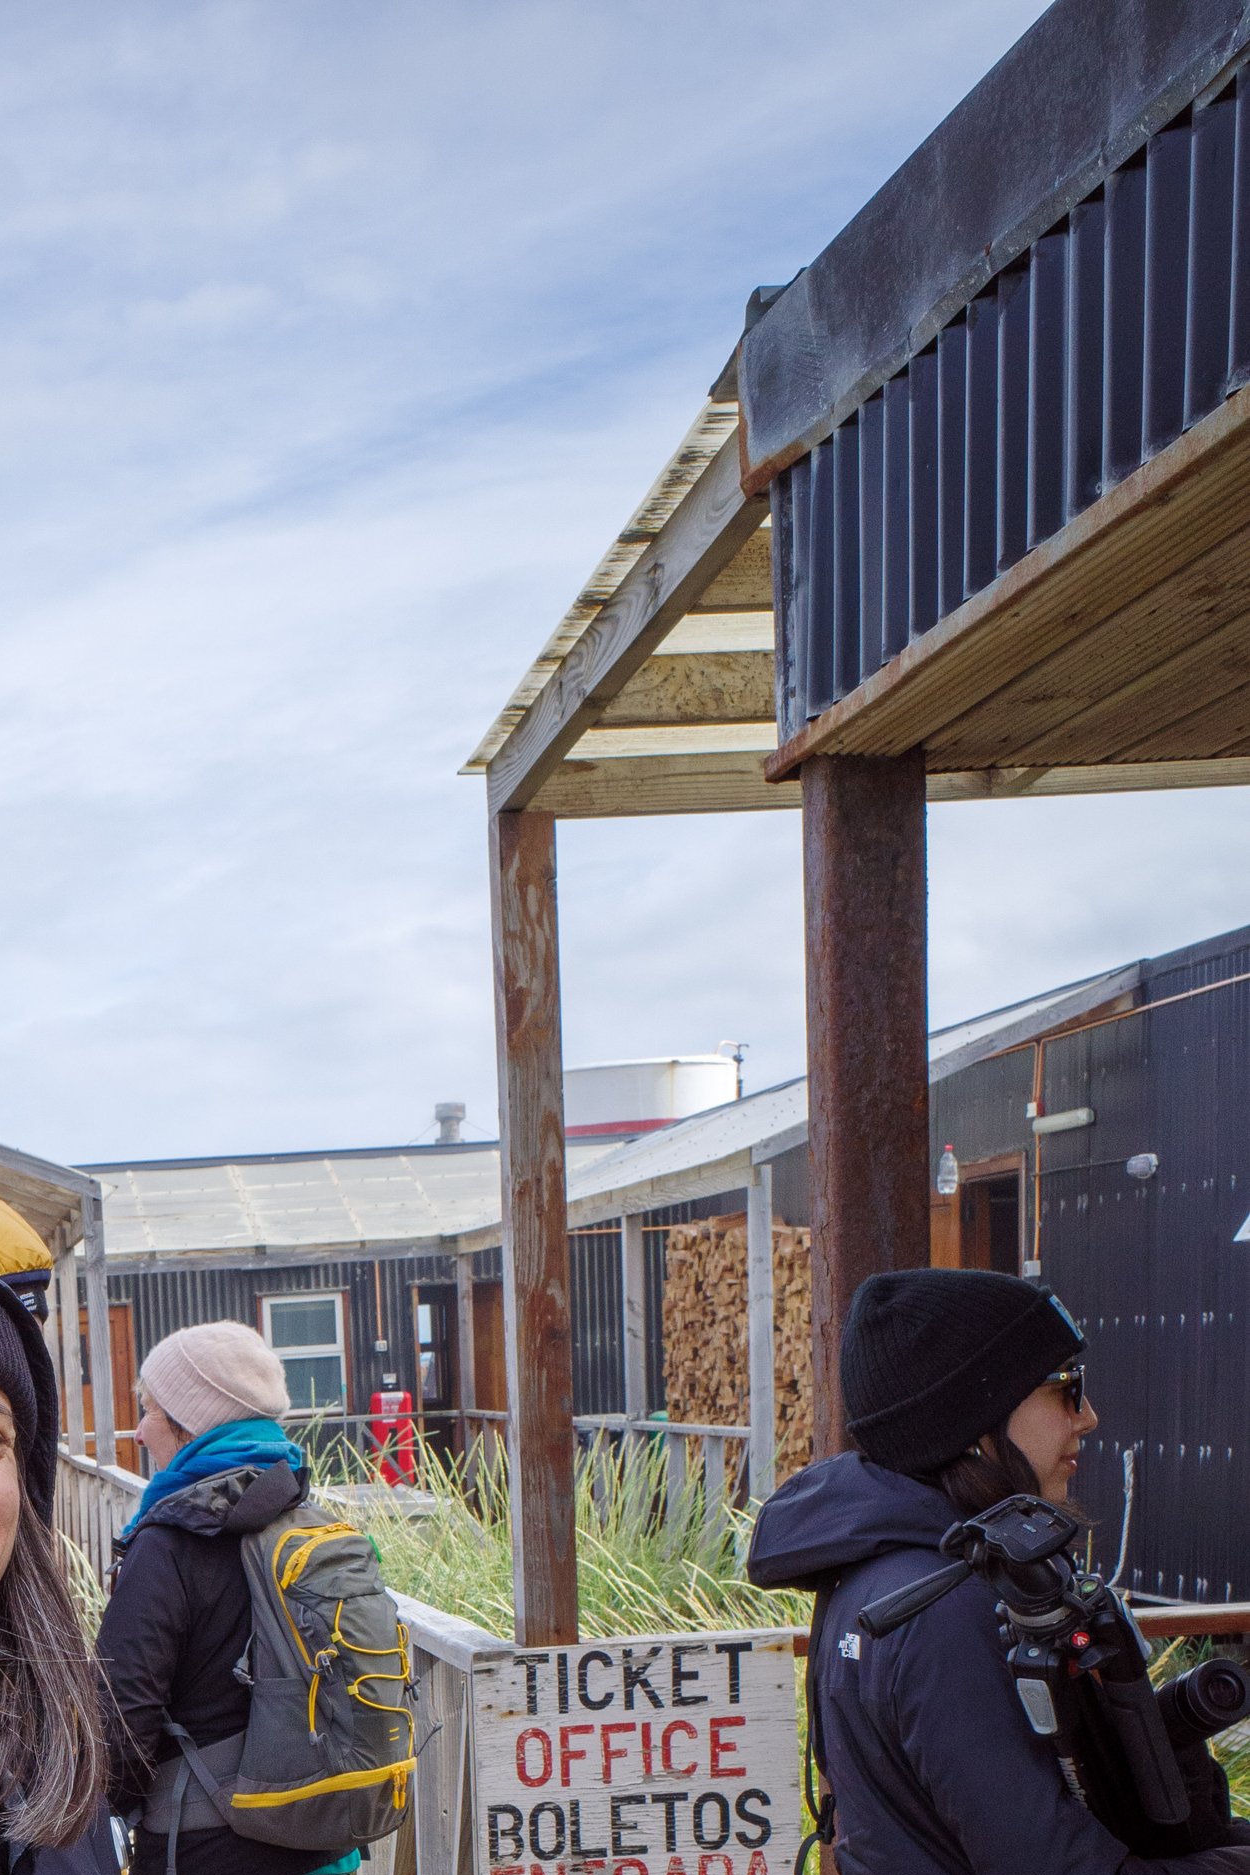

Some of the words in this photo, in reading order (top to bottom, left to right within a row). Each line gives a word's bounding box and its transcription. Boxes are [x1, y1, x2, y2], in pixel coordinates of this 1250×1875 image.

[512, 1641, 753, 1716] TICKET
[515, 1715, 747, 1788] OFFICE
[487, 1788, 772, 1862] BOLETOS
